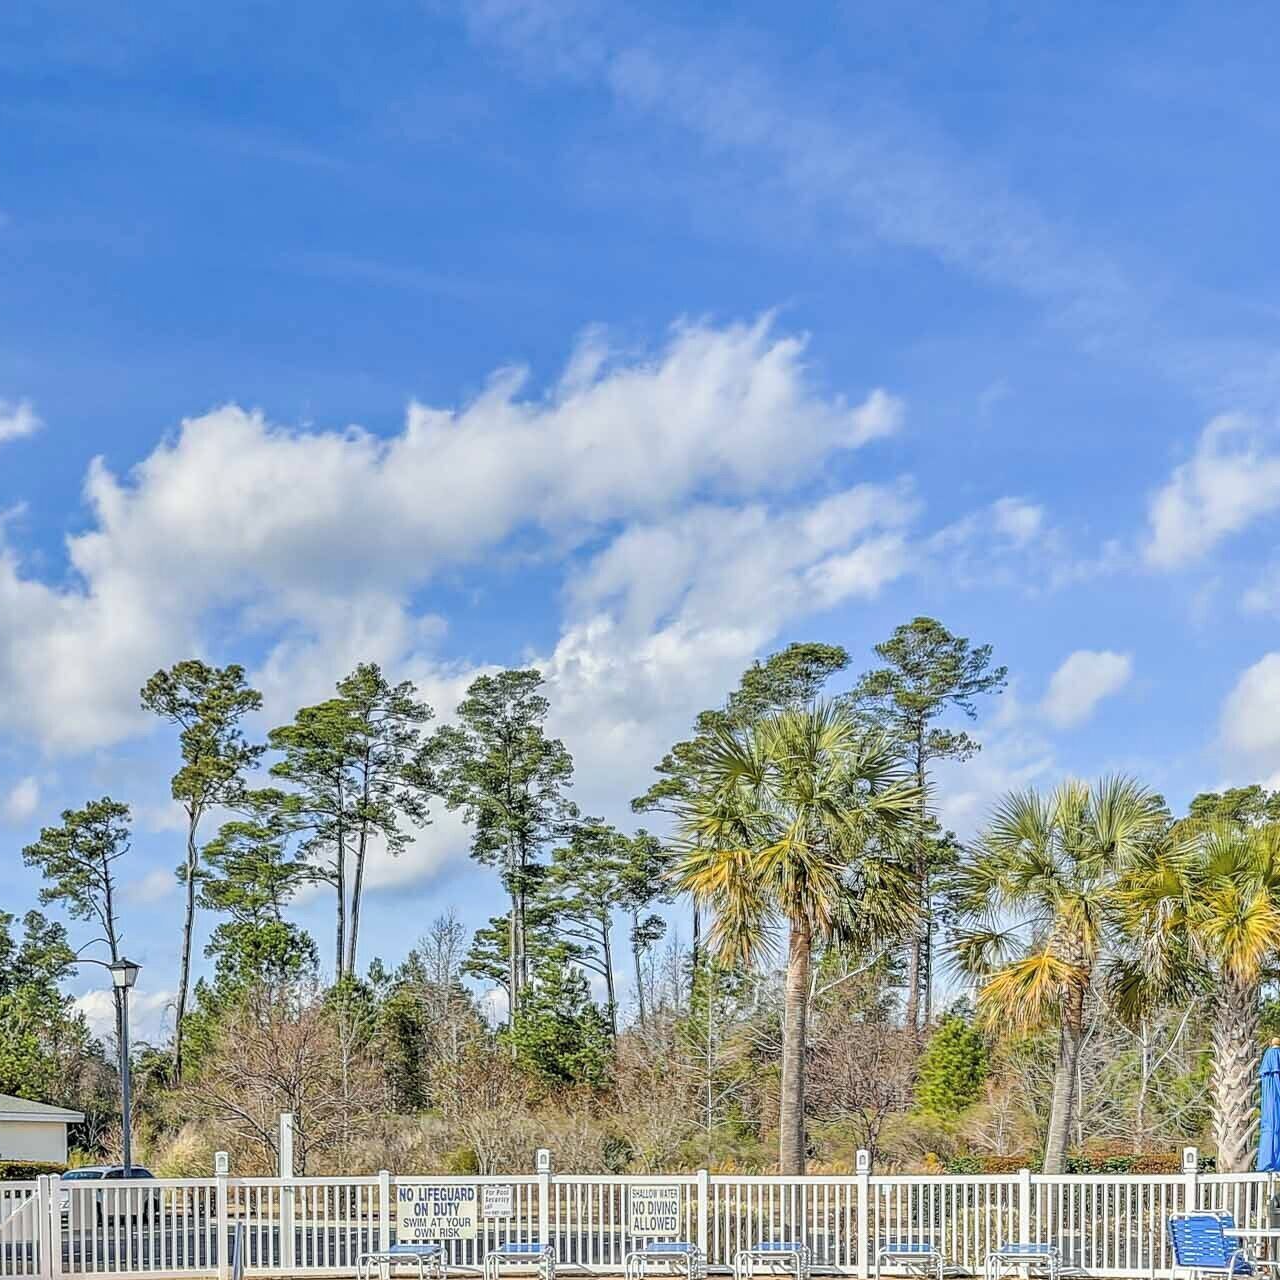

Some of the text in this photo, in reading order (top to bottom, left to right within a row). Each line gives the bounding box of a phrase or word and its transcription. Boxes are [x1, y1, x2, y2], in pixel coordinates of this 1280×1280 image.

[400, 1188, 474, 1201] NO LIFEGUARD
[414, 1203, 460, 1216] ON DUTY
[632, 1201, 677, 1215] NO DIVING
[403, 1218, 471, 1228] SWIM AT YOUR
[634, 1217, 677, 1231] ALLOWED
[414, 1228, 460, 1238] OWN RISK
